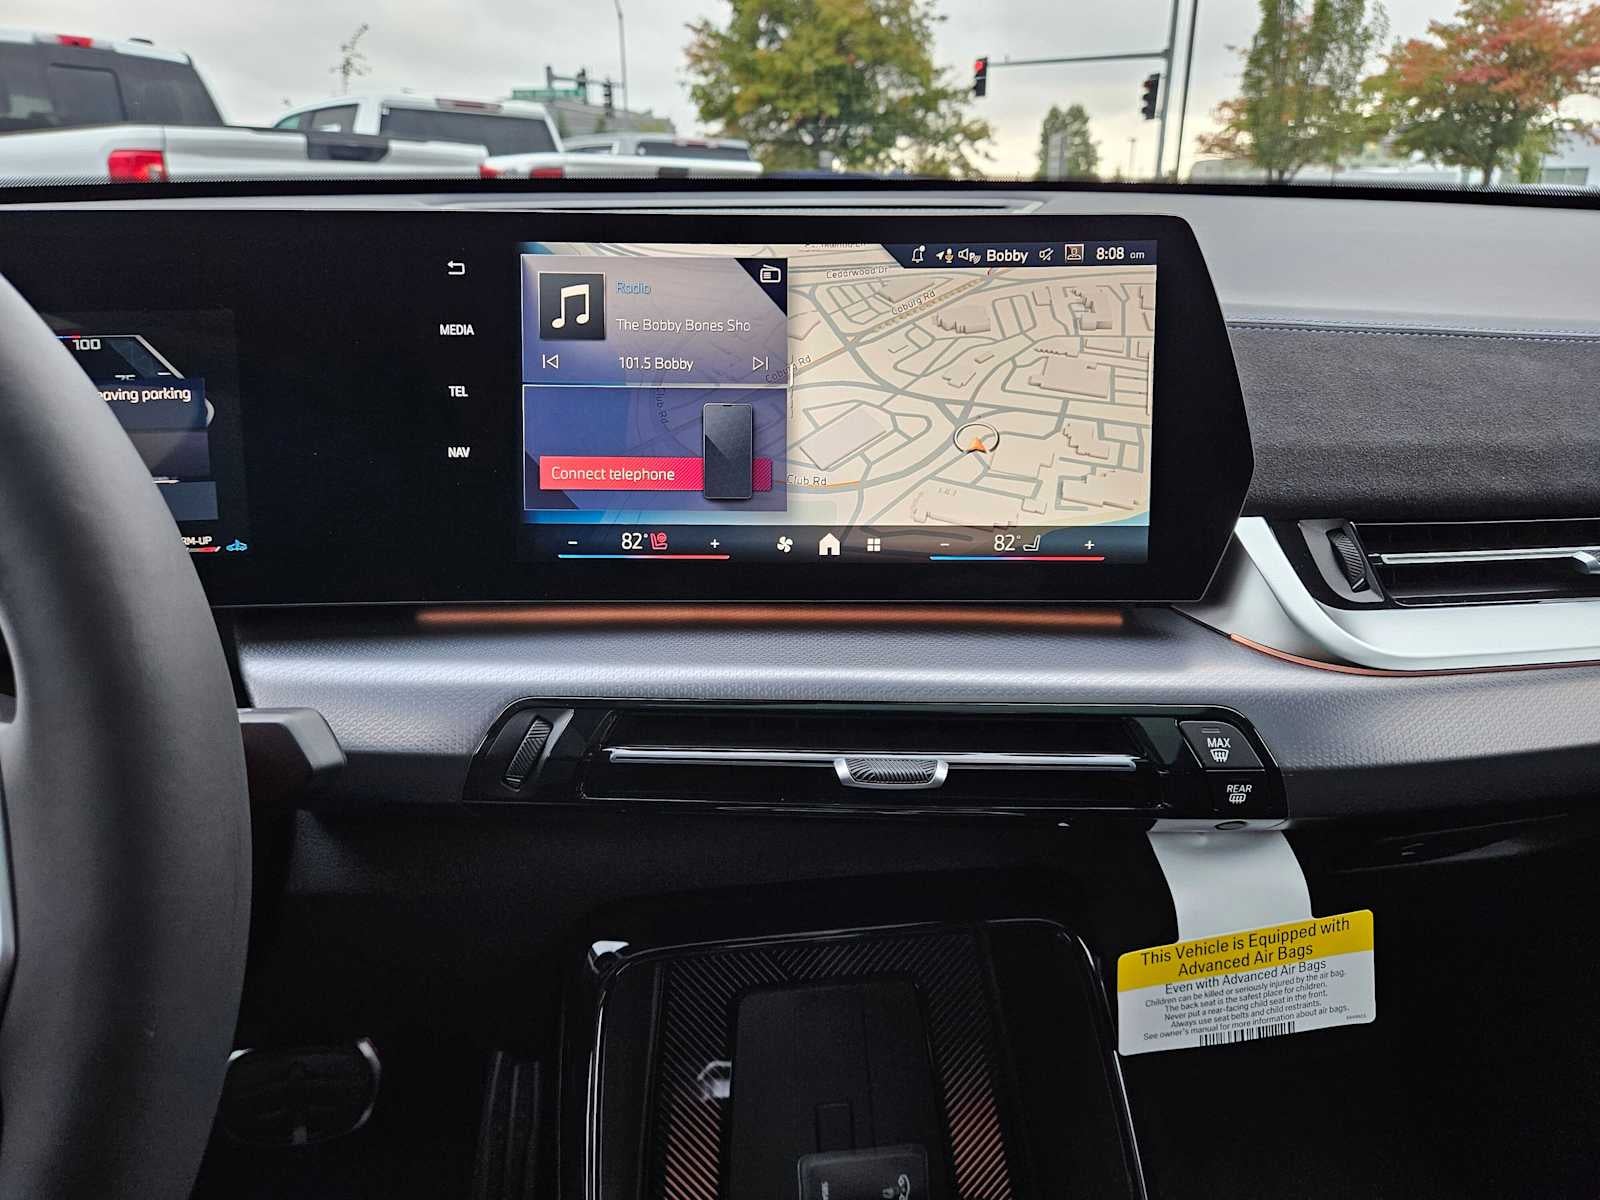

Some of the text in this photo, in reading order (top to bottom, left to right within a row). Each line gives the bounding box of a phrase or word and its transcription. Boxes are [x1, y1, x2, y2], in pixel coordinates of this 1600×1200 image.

[986, 248, 1029, 264] Bobby
[1095, 247, 1145, 260] 8:08 am
[826, 266, 888, 279] Cedarwood Dr
[616, 280, 651, 295] Radio
[891, 289, 936, 315] Coburg Rd
[439, 324, 475, 336] MEDIA
[616, 318, 750, 333] The Bobby Bones Sho
[72, 338, 101, 350] 100
[618, 356, 694, 372] 101.5 Bobby
[141, 387, 192, 403] parking
[448, 386, 468, 398] TEL
[447, 446, 471, 459] NAV
[551, 466, 676, 485] Connect telephone
[812, 476, 828, 487] Rd
[1206, 737, 1232, 749] MAX
[1226, 784, 1253, 793] REAR
[1141, 917, 1350, 966] This Vehicle is Equipped with
[1178, 944, 1313, 976] Advanced Air Bags
[1165, 960, 1327, 994] Even with Advanced Air Bags
